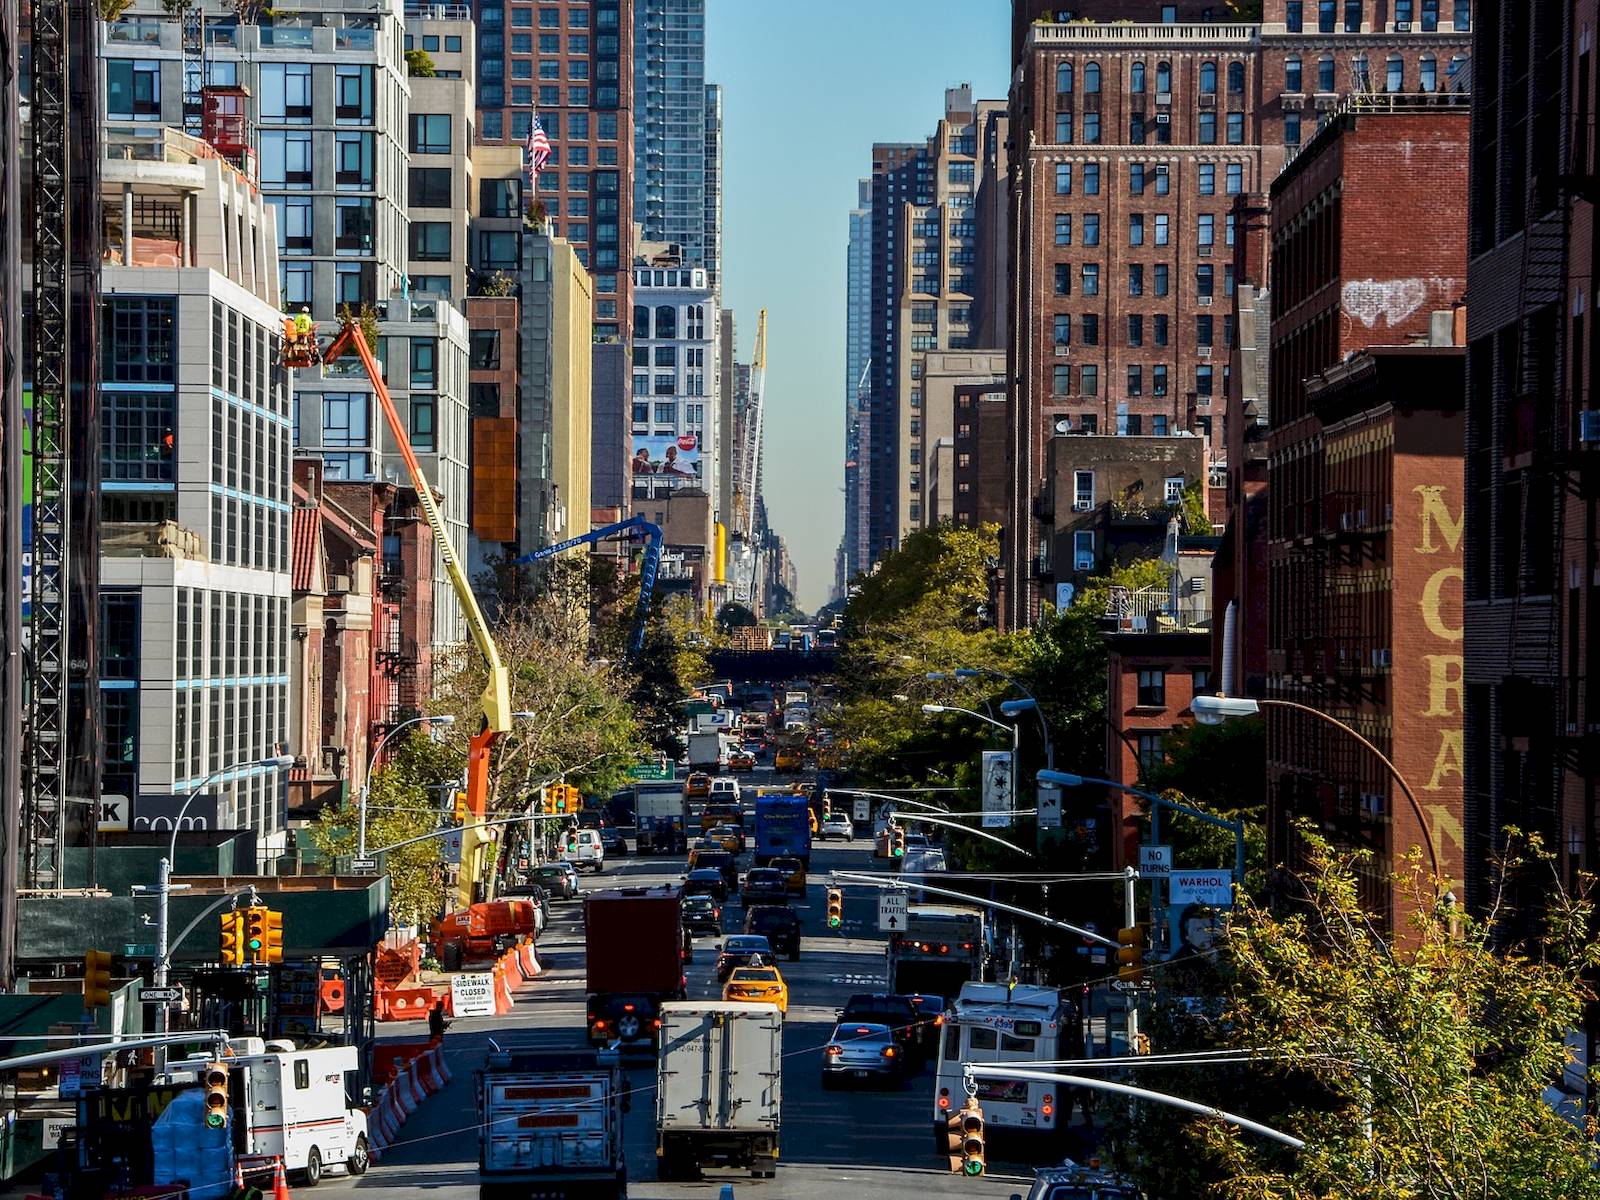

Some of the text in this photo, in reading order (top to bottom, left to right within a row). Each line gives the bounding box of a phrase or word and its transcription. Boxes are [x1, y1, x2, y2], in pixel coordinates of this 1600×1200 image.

[1148, 851, 1162, 861] NO
[1141, 864, 1170, 873] TURNS
[1179, 877, 1224, 887] WARHOL
[886, 897, 900, 905] ALL
[881, 906, 908, 915] TRAFFIC
[455, 978, 490, 988] SIDEWALK
[143, 990, 177, 1000] ONE WAY
[460, 988, 486, 997] CLOSED
